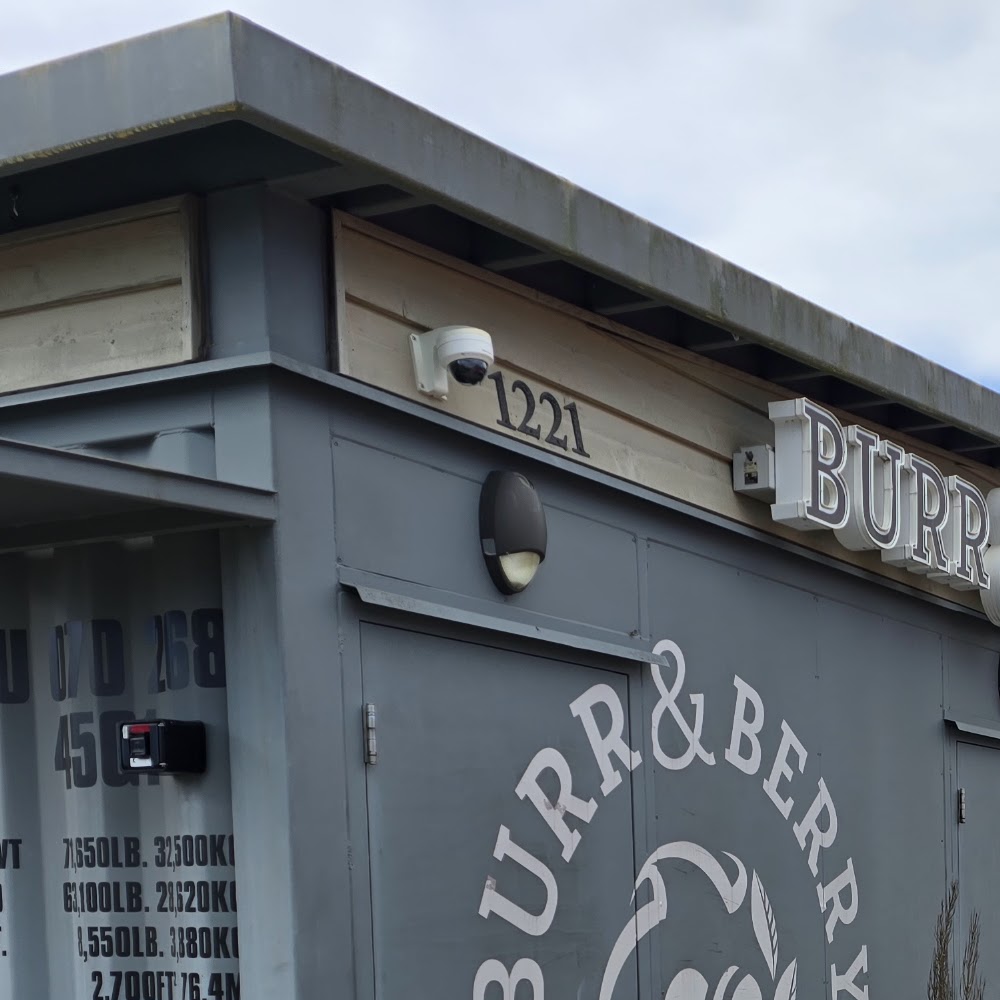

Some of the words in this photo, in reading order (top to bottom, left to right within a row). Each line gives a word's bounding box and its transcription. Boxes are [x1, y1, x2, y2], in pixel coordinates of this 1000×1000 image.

[488, 371, 590, 458] 1221
[803, 397, 990, 590] BURR
[50, 619, 125, 702] 070
[146, 608, 227, 695] 268
[651, 639, 715, 770] &
[63, 881, 150, 917] 63,100LB.
[77, 926, 164, 962] 8,550LB.
